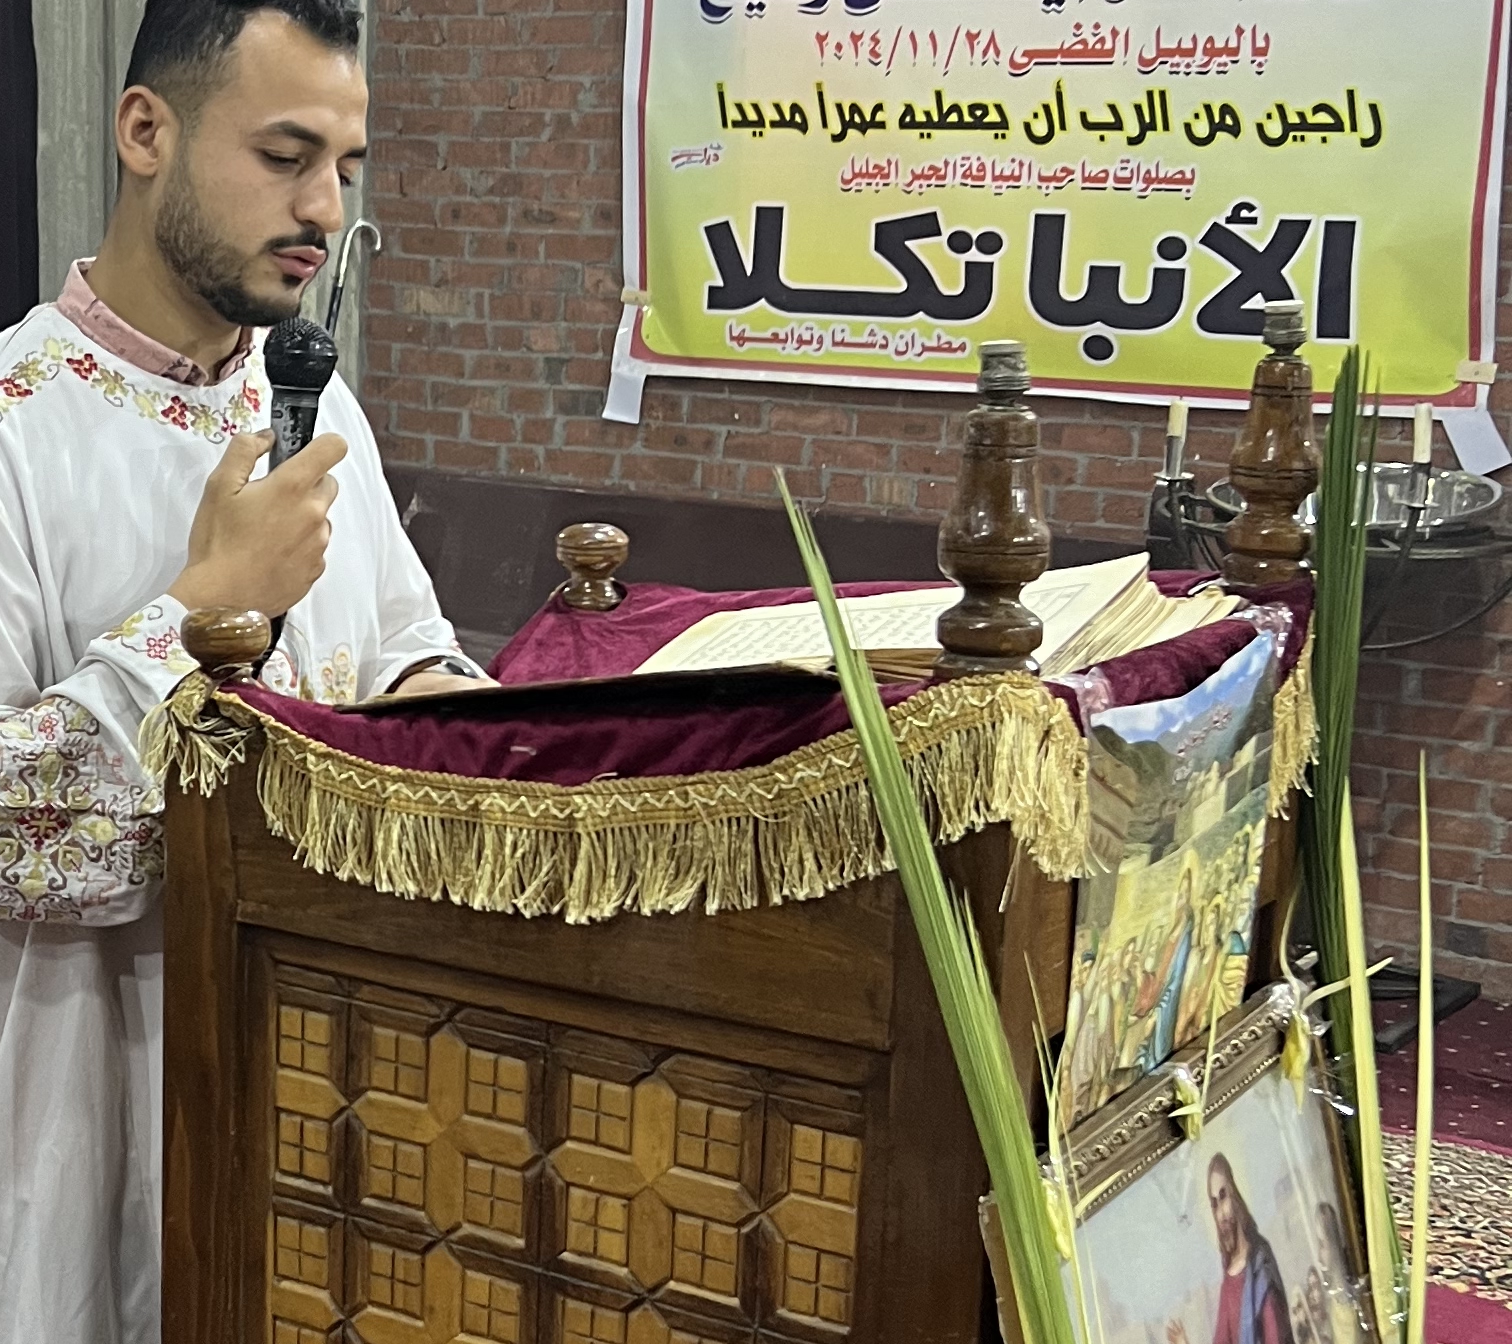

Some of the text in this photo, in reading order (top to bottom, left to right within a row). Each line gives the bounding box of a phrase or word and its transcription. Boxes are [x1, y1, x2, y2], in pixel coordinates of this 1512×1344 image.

[898, 89, 1010, 140] يعطيه
[1023, 78, 1067, 146] أن
[1080, 89, 1170, 146] الرب
[1184, 103, 1242, 147] من
[1256, 88, 1383, 148] راجين
[840, 156, 899, 195] الجليل
[903, 157, 956, 196] الحبر
[1112, 157, 1197, 199] بصلوات
[703, 201, 1357, 362] الأنبا تكلا
[728, 323, 968, 357] مطران دشنا وتوابعها
